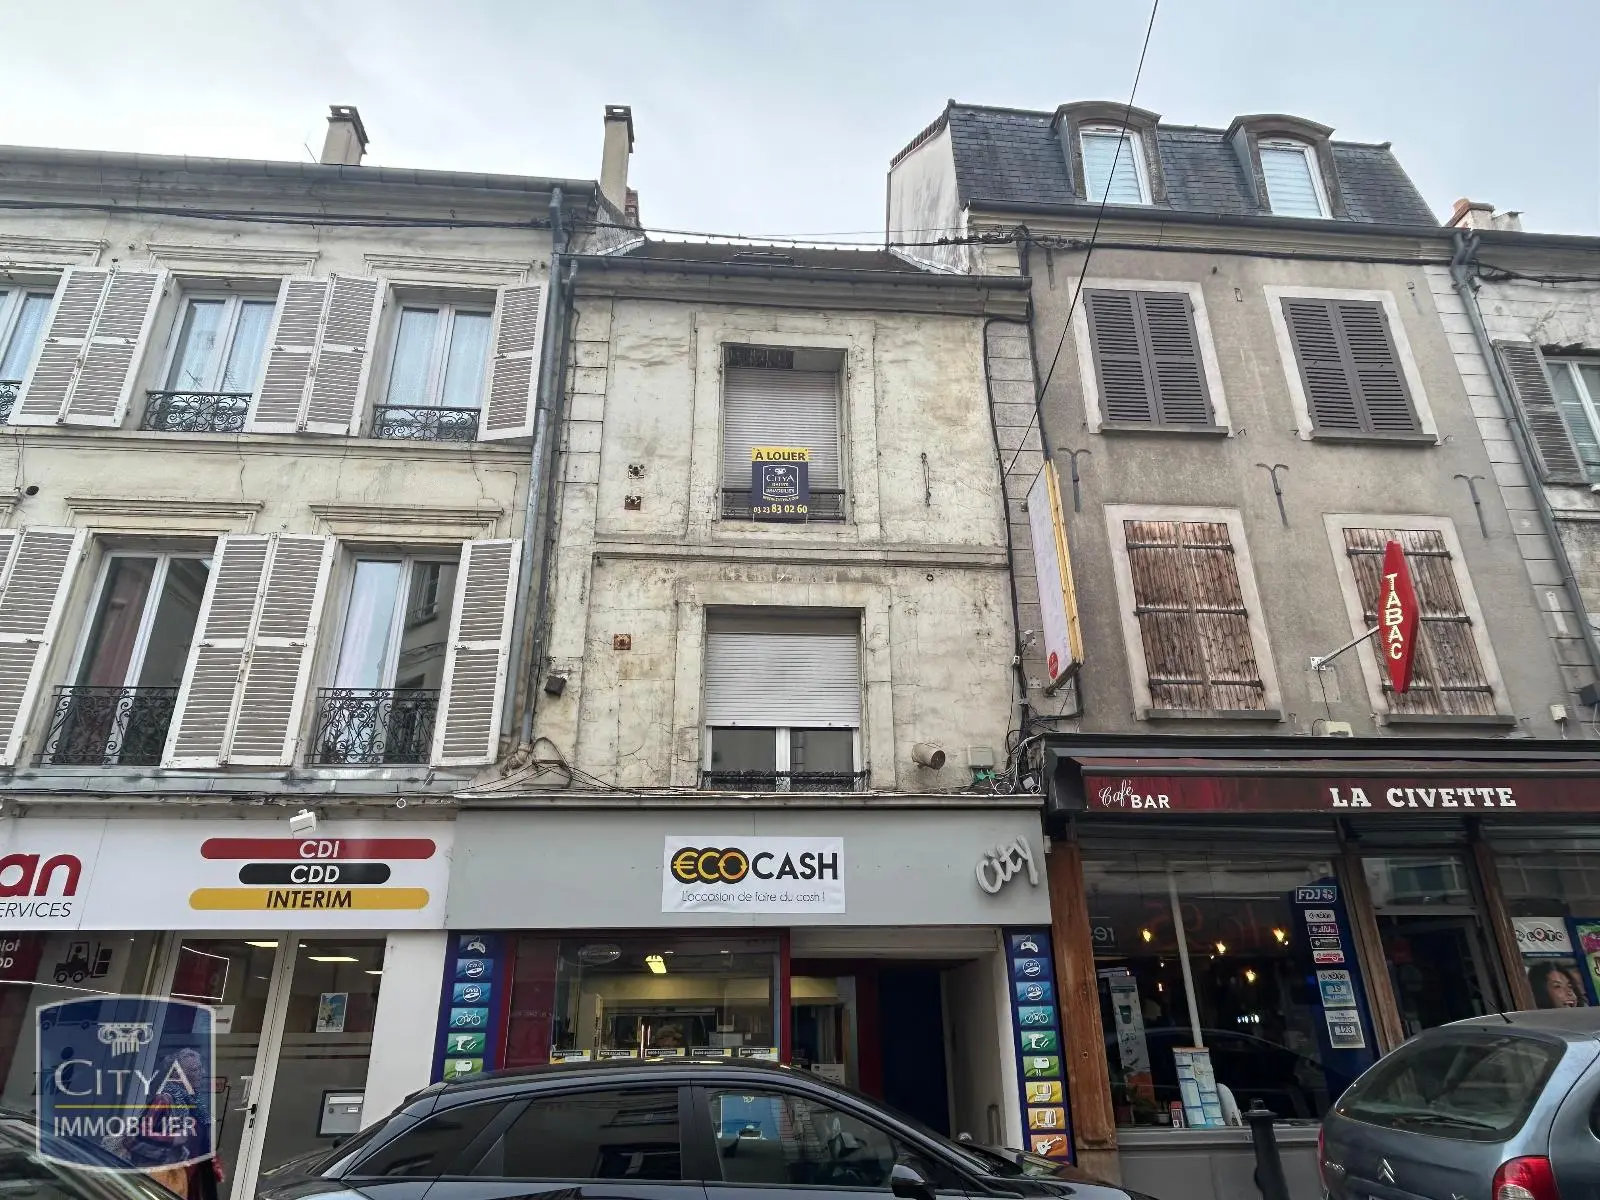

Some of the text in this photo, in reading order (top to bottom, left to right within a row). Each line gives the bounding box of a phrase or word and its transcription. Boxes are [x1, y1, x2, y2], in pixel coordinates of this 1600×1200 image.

[766, 451, 806, 461] LOUER
[753, 503, 808, 514] 03 23 83 02 60
[1385, 573, 1404, 660] TABAC
[1098, 779, 1171, 809] Café BAR
[1329, 787, 1517, 808] LA CIVETTE
[300, 840, 339, 858] CDI
[290, 865, 340, 883] CDD
[266, 890, 352, 909] INTERIM
[681, 890, 735, 902] L'occasion
[737, 891, 753, 902] de
[755, 891, 777, 902] faire
[779, 891, 793, 902] du
[796, 891, 820, 902] cash
[1298, 889, 1321, 900] FDJ
